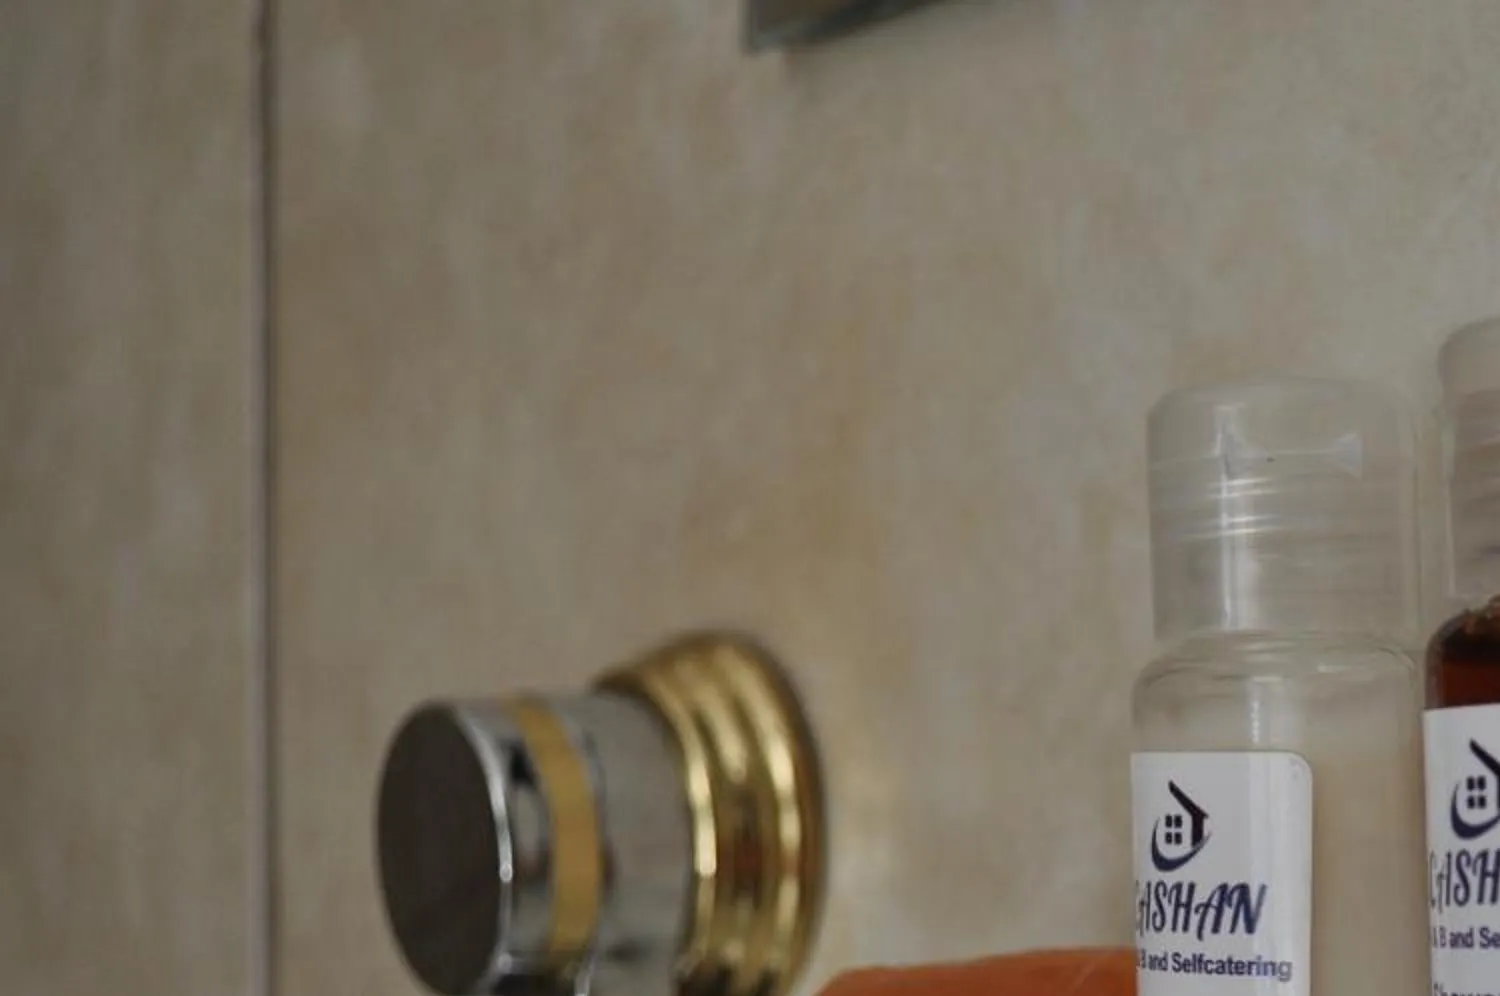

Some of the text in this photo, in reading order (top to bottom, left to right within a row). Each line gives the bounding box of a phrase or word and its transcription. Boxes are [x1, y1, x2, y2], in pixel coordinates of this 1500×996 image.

[1136, 879, 1267, 941] ASHAN
[1450, 927, 1474, 949] and
[1172, 951, 1293, 982] Selfcatering
